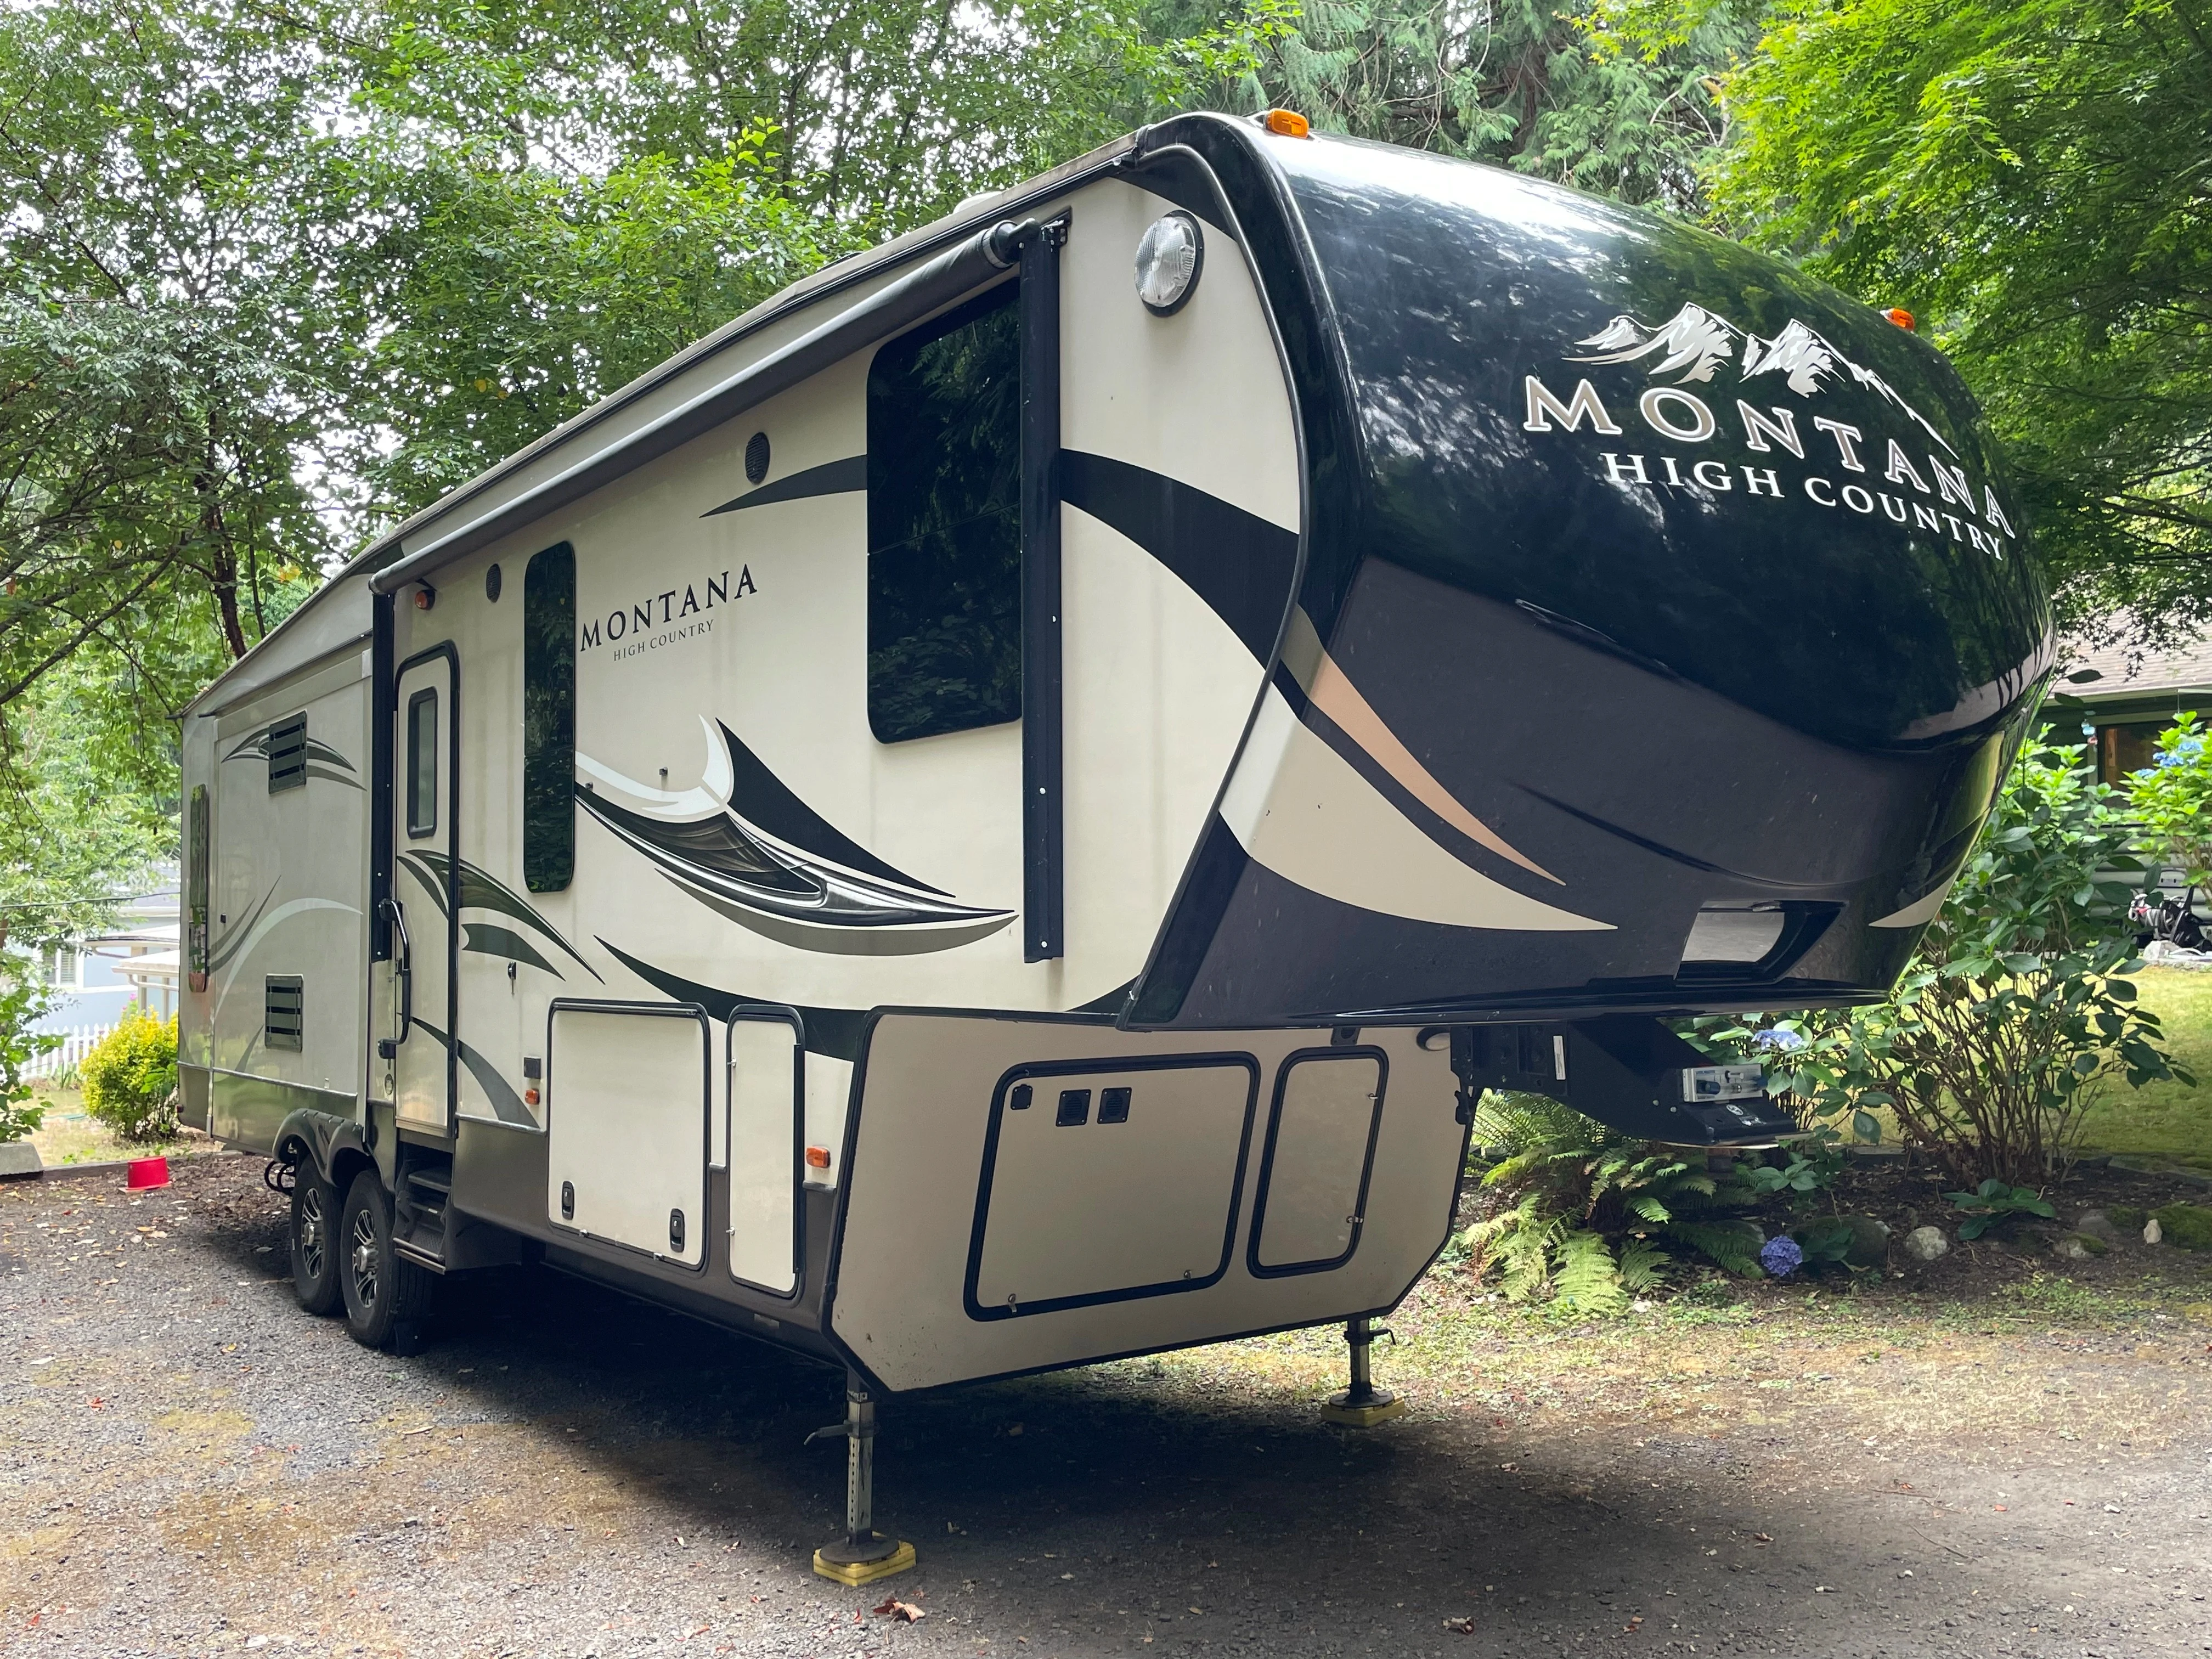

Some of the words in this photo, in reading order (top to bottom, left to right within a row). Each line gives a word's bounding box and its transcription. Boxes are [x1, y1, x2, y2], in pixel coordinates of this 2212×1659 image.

[1523, 375, 2016, 539] MONTANA
[1599, 452, 1786, 498] HIGH
[1804, 476, 2004, 561] COUNTRY
[580, 563, 758, 652] MONTANA
[613, 641, 646, 661] HIGH
[650, 619, 714, 649] COUNTRY
